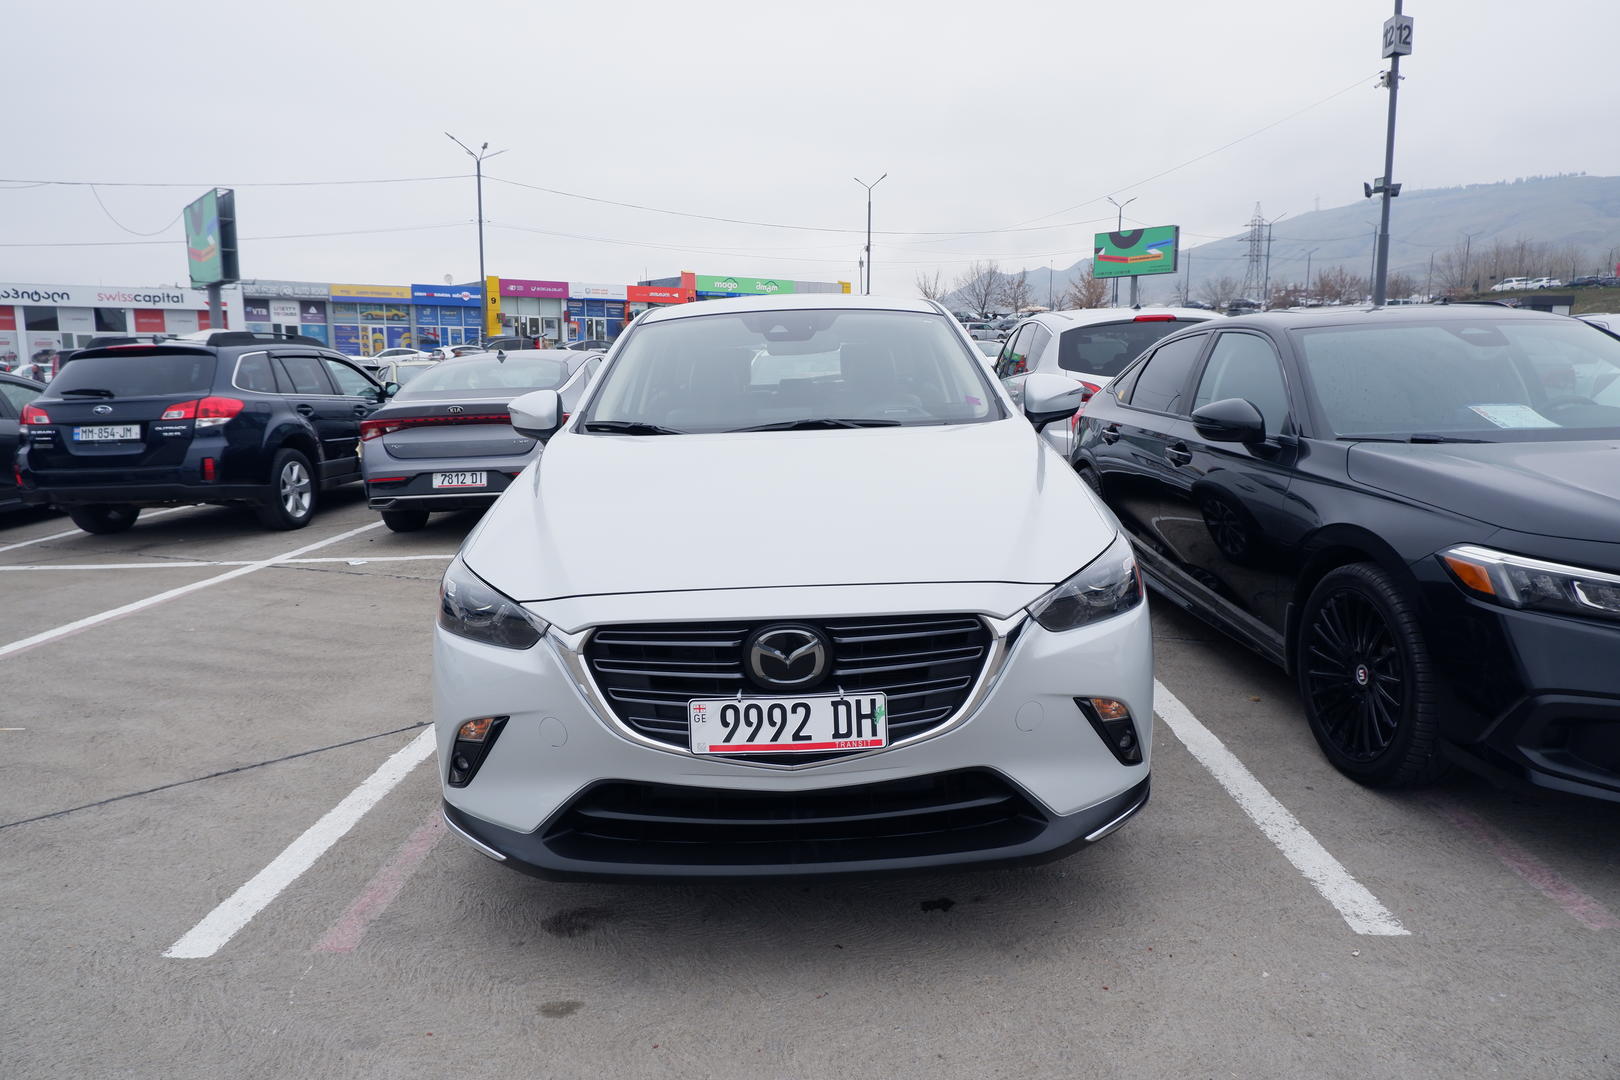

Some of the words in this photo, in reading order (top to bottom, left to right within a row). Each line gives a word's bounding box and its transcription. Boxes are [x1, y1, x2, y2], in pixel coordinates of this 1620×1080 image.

[1383, 25, 1394, 48] 12
[1397, 24, 1411, 45] 12
[714, 281, 738, 291] mogo
[0, 288, 70, 303] აპიტალი
[97, 291, 184, 305] swisscapital
[81, 427, 132, 439] MM-854-JM
[440, 473, 466, 485] 7812
[471, 472, 482, 484] DI
[694, 714, 706, 723] GE
[720, 702, 812, 743] 9992
[831, 698, 877, 739] DH
[835, 740, 871, 748] TRANSIT
